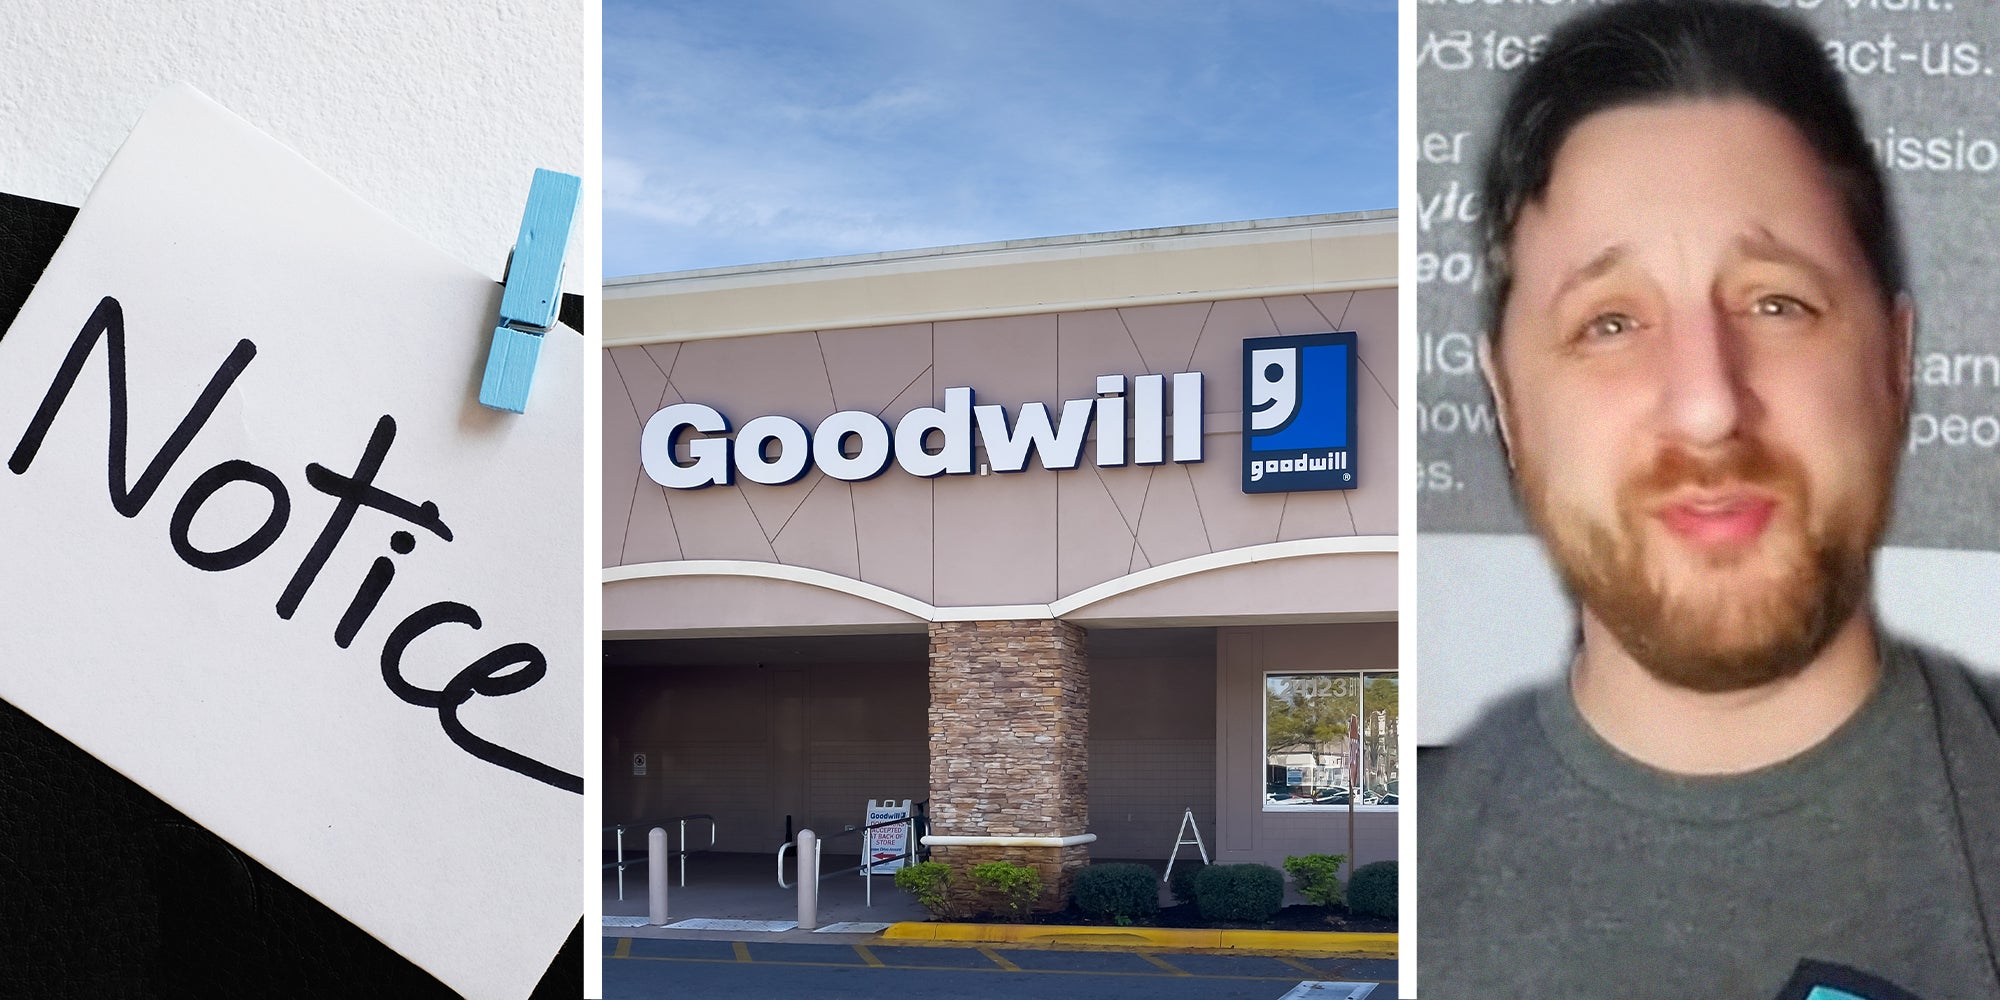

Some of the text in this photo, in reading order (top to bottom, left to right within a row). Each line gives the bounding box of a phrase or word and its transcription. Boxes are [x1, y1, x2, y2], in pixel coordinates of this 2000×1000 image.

[1416, 126, 2000, 172] er issio
[639, 372, 1204, 491] Goodwill
[1908, 412, 2000, 455] peo
[1250, 451, 1347, 482] goodwill
[8, 296, 584, 795] Notice
[1280, 677, 1347, 698] 24123
